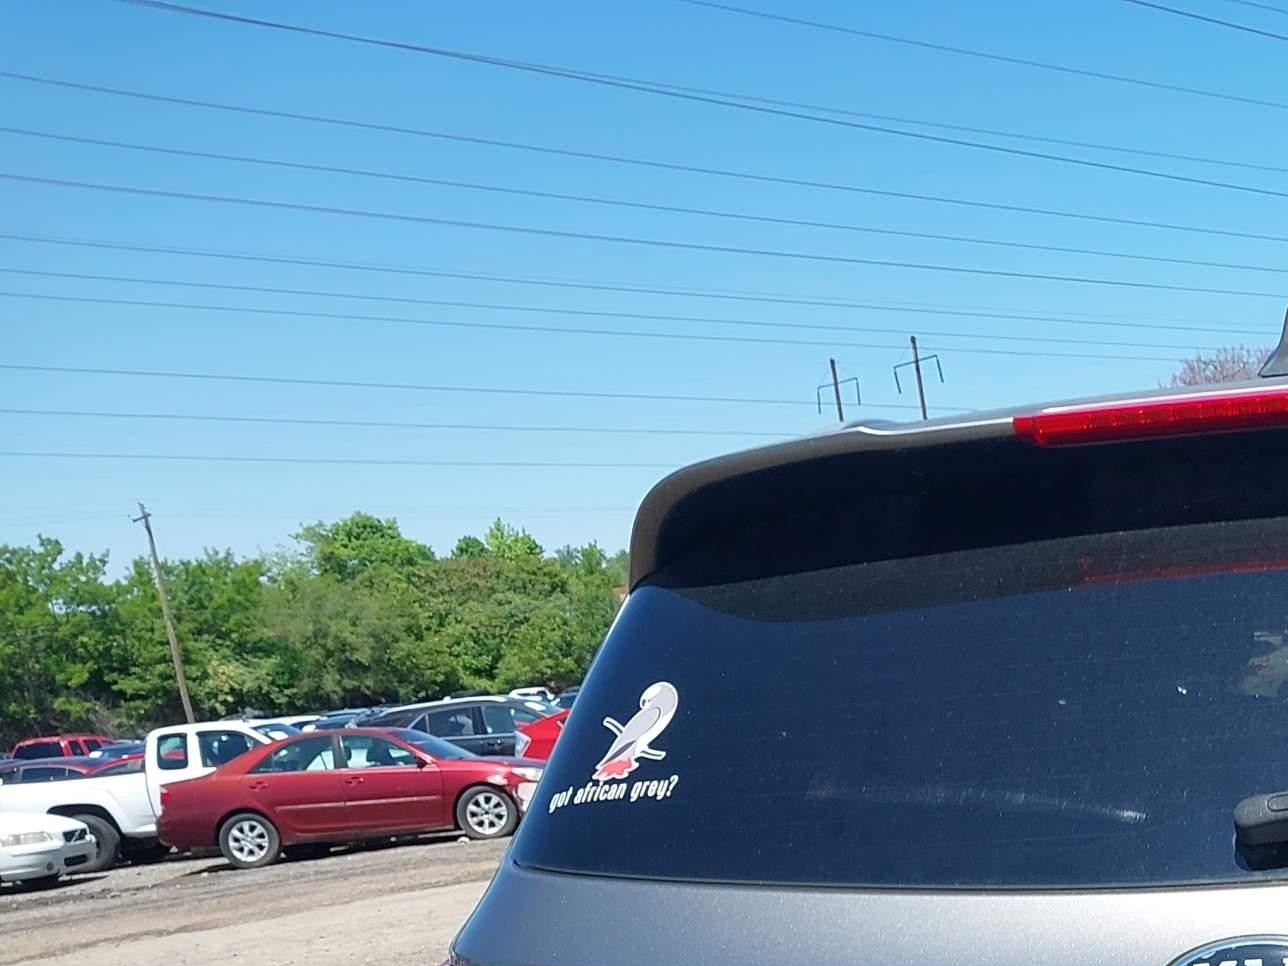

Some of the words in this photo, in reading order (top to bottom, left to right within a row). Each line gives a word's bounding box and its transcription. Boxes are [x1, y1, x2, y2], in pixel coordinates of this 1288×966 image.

[549, 786, 573, 814] got
[573, 781, 626, 806] african
[630, 775, 679, 803] grey?
